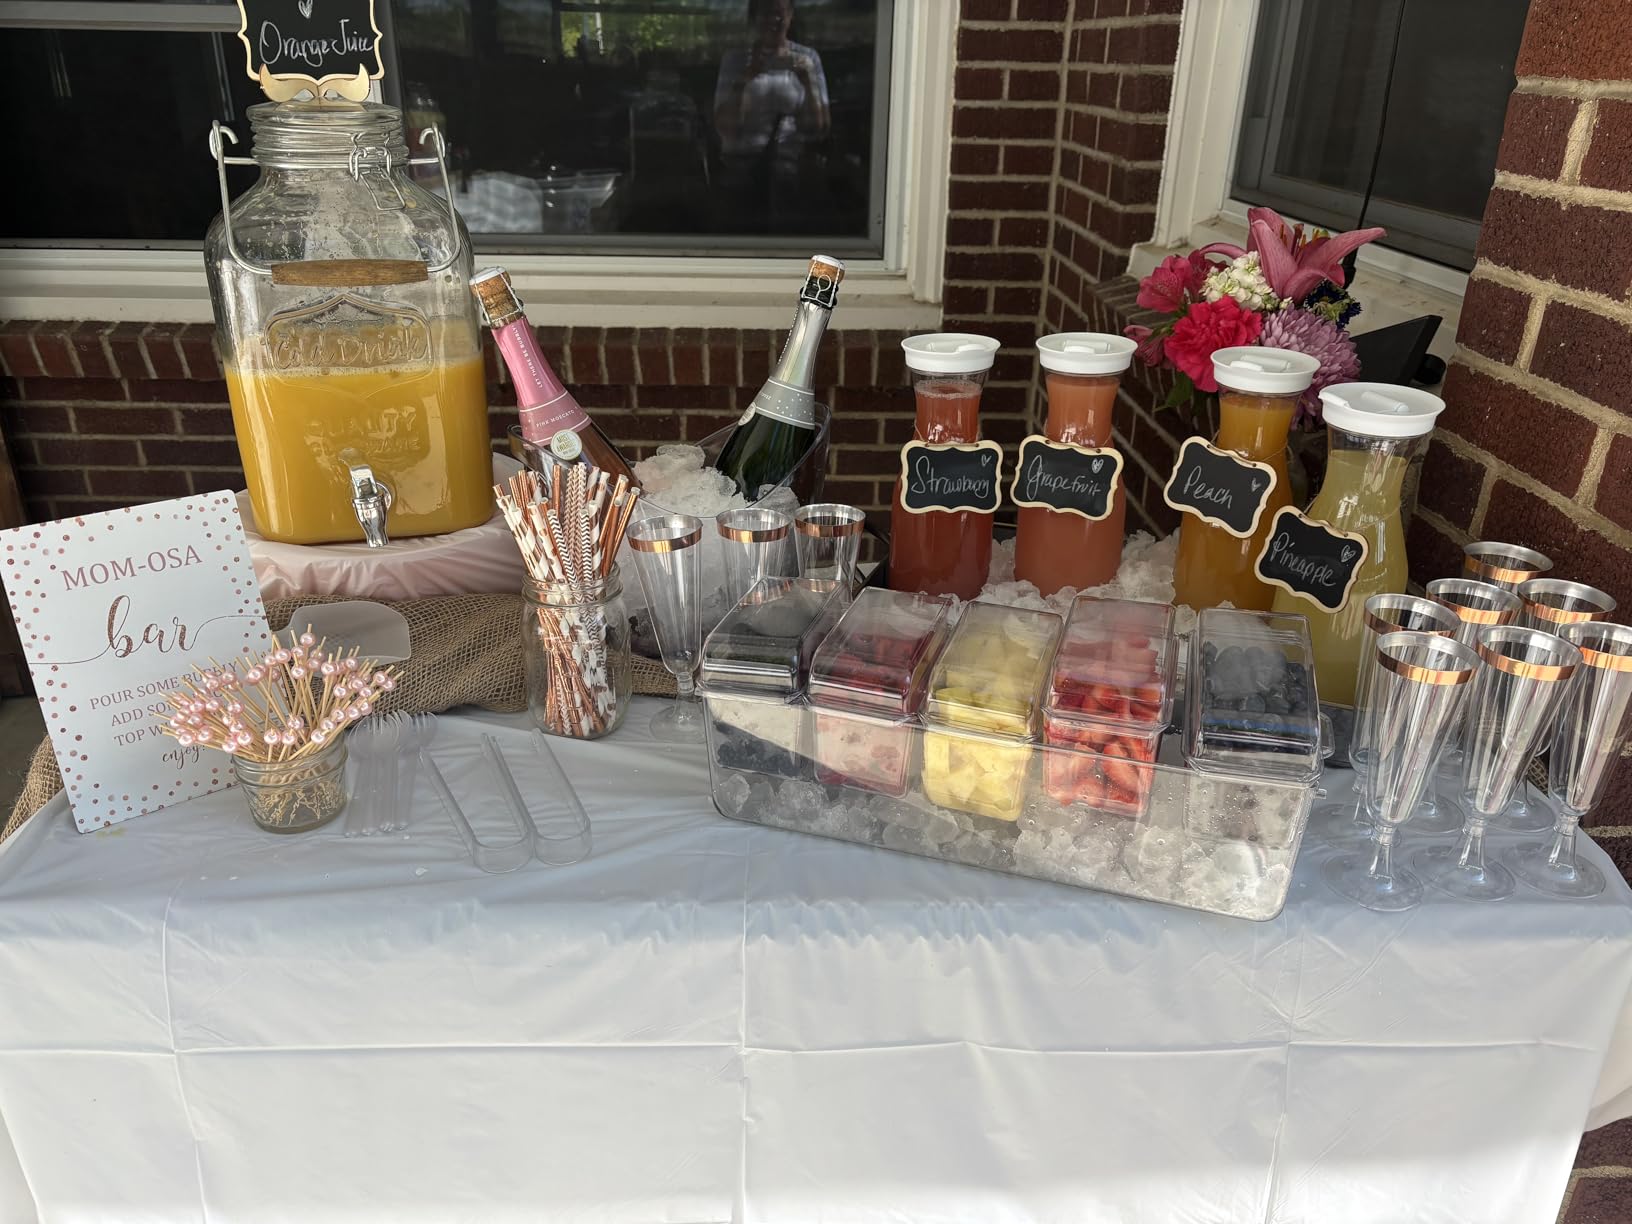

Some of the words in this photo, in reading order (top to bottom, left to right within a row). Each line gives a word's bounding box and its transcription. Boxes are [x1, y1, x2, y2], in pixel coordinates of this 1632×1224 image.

[259, 20, 329, 67] Orange
[536, 418, 549, 428] PINK
[1183, 465, 1233, 510] Peach
[61, 545, 203, 590] MOM-OSA
[1270, 532, 1336, 586] Pineapple
[90, 689, 134, 710] POUR
[136, 676, 180, 698] SOME
[111, 708, 143, 727] ADD
[114, 729, 145, 747] TOP
